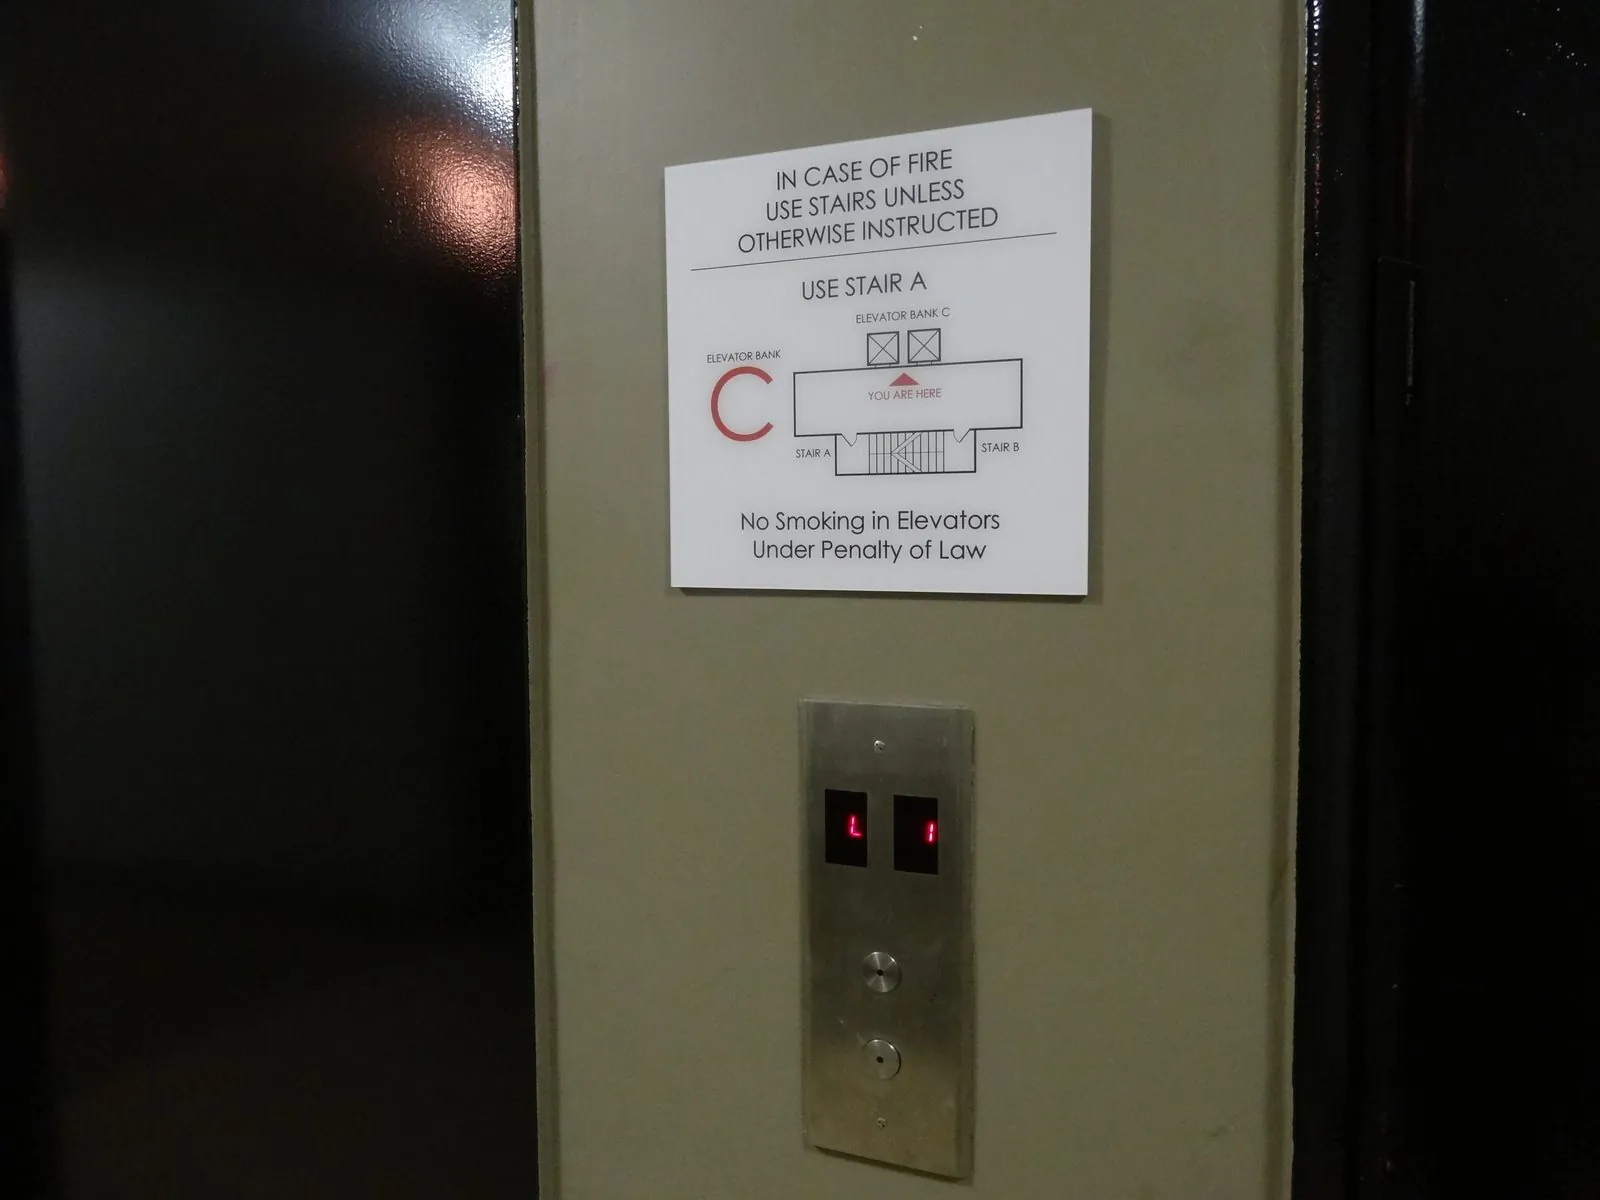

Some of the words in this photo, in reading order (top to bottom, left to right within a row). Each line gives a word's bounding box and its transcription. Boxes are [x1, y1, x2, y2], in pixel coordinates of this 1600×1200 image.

[776, 169, 797, 192] IN
[803, 160, 863, 187] CASE
[869, 155, 901, 179] OF
[908, 148, 953, 175] FIRE
[766, 198, 803, 222] USE
[808, 189, 877, 217] STAIRS
[884, 178, 965, 208] UNLESS
[737, 221, 856, 254] OTHERWISE
[862, 206, 999, 241] INSTRUCTED
[801, 278, 840, 301] USE
[844, 273, 903, 297] STAIR
[909, 271, 928, 292] A
[855, 310, 908, 324] ELEVATOR
[909, 307, 940, 320] BANK
[941, 306, 951, 318] C
[706, 351, 754, 364] ELEVATOR
[755, 348, 782, 361] BANK
[710, 364, 775, 443] C
[867, 390, 891, 402] YOU
[892, 388, 914, 401] ARE
[915, 387, 943, 400] HERE
[795, 448, 821, 459] STAIR
[821, 448, 832, 459] A
[980, 441, 1011, 453] STAIR
[1012, 441, 1020, 452] B
[740, 511, 770, 531] No
[775, 510, 865, 536] Smoking
[871, 510, 890, 531] in
[897, 509, 1001, 531] Elevators
[753, 539, 816, 560] Under
[821, 539, 903, 565] Penalty
[909, 538, 933, 560] of
[939, 539, 987, 561] Law
[849, 814, 863, 837] L
